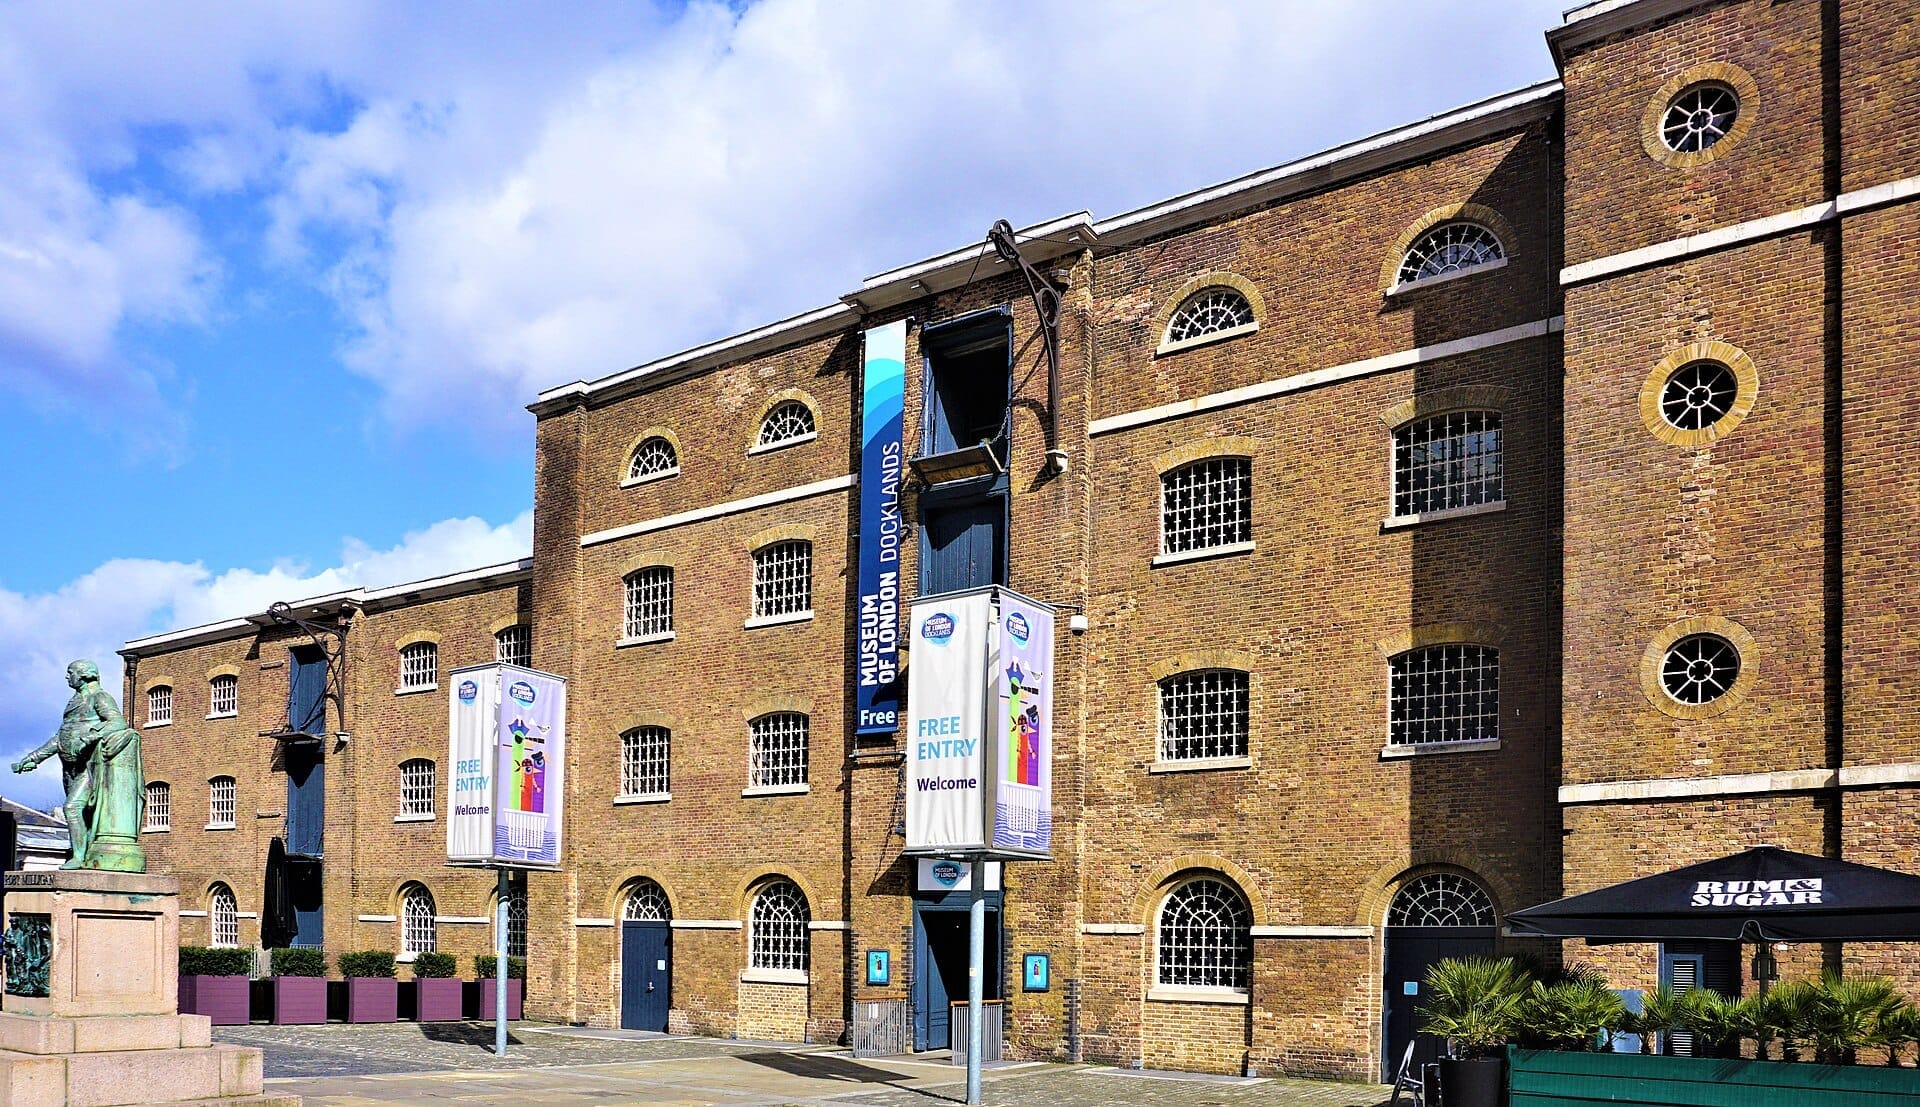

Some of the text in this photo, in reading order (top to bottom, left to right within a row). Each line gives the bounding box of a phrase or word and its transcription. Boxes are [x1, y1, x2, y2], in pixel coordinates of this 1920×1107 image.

[879, 441, 900, 684] OF LONDON DOCKLANDS
[861, 594, 878, 686] MUSEUM
[860, 710, 896, 726] Free
[918, 716, 960, 737] FREE
[918, 738, 977, 760] ENTRY
[457, 759, 480, 774] FREE
[456, 776, 490, 792] ENTRY
[916, 776, 977, 792] Welcome
[455, 804, 490, 816] Welcome
[1691, 891, 1823, 907] SUGAR
